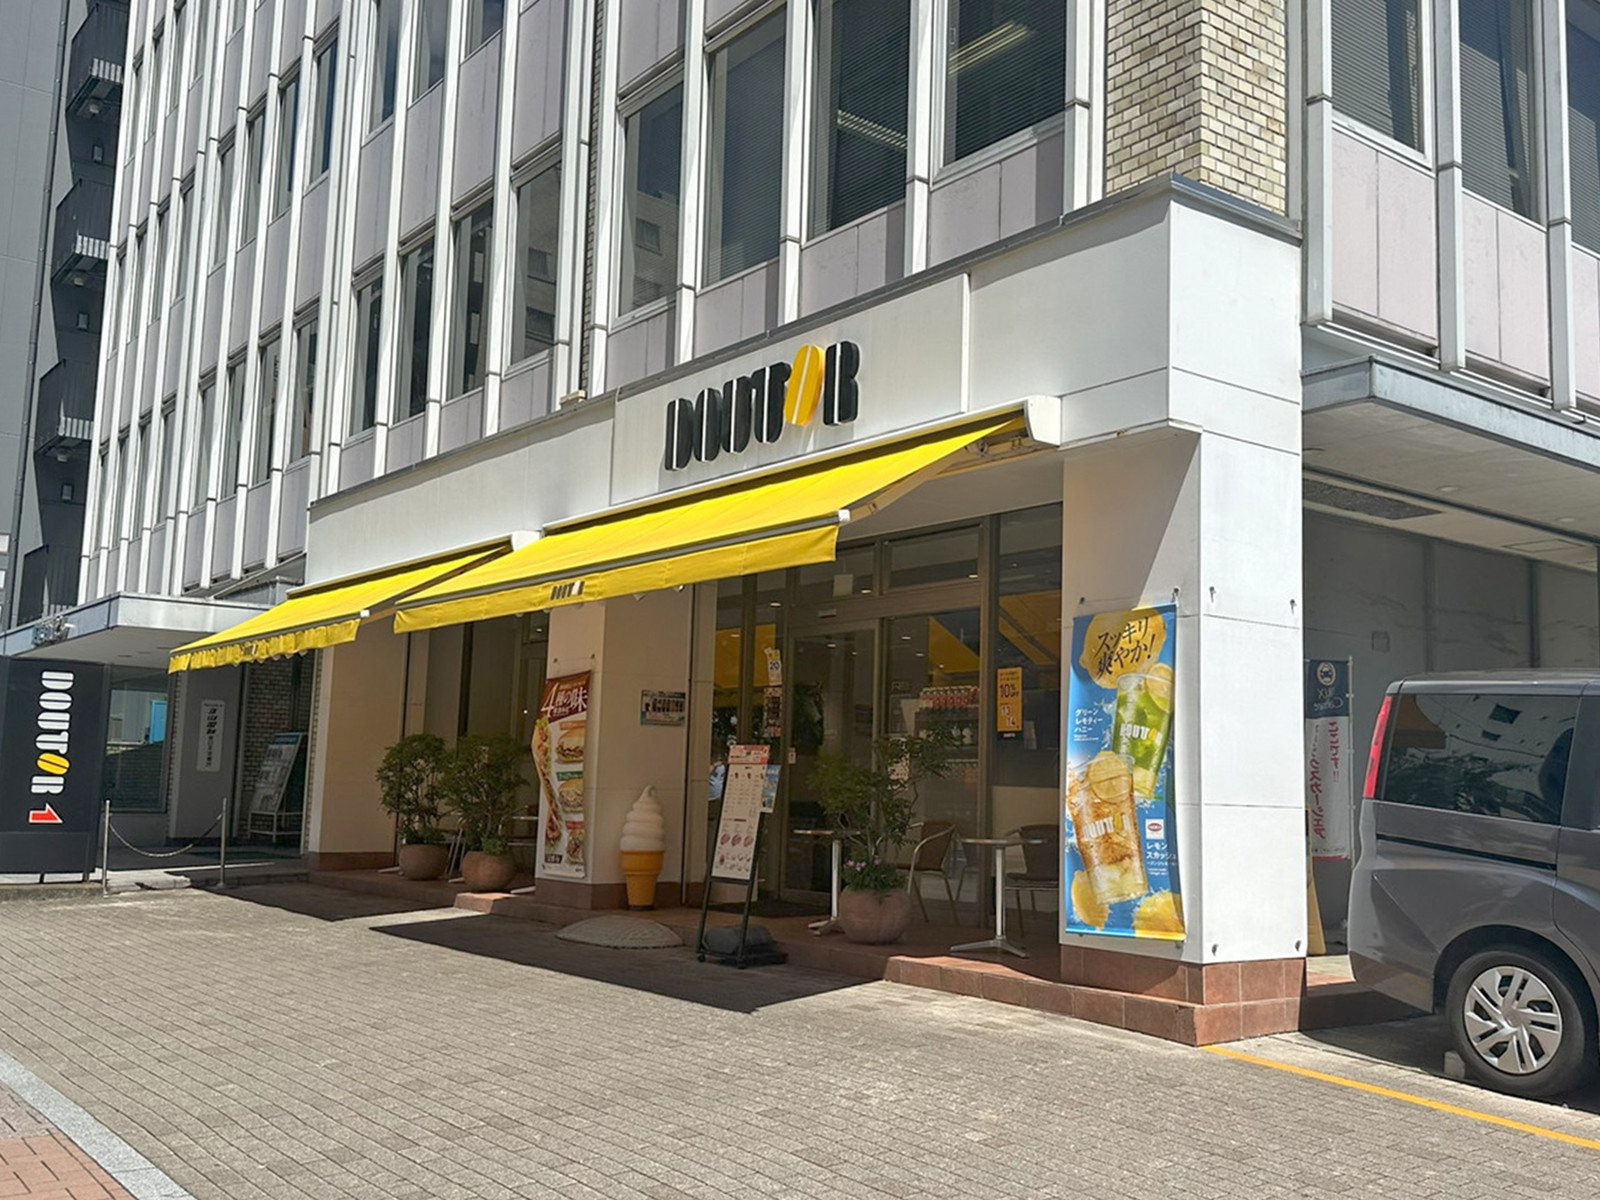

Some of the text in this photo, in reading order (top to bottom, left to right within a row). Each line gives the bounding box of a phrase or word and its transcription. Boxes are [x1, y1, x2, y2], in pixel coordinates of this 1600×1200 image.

[664, 340, 861, 471] DOUTOR
[1093, 616, 1150, 659] スッキリ
[30, 671, 75, 794] DOUTOR
